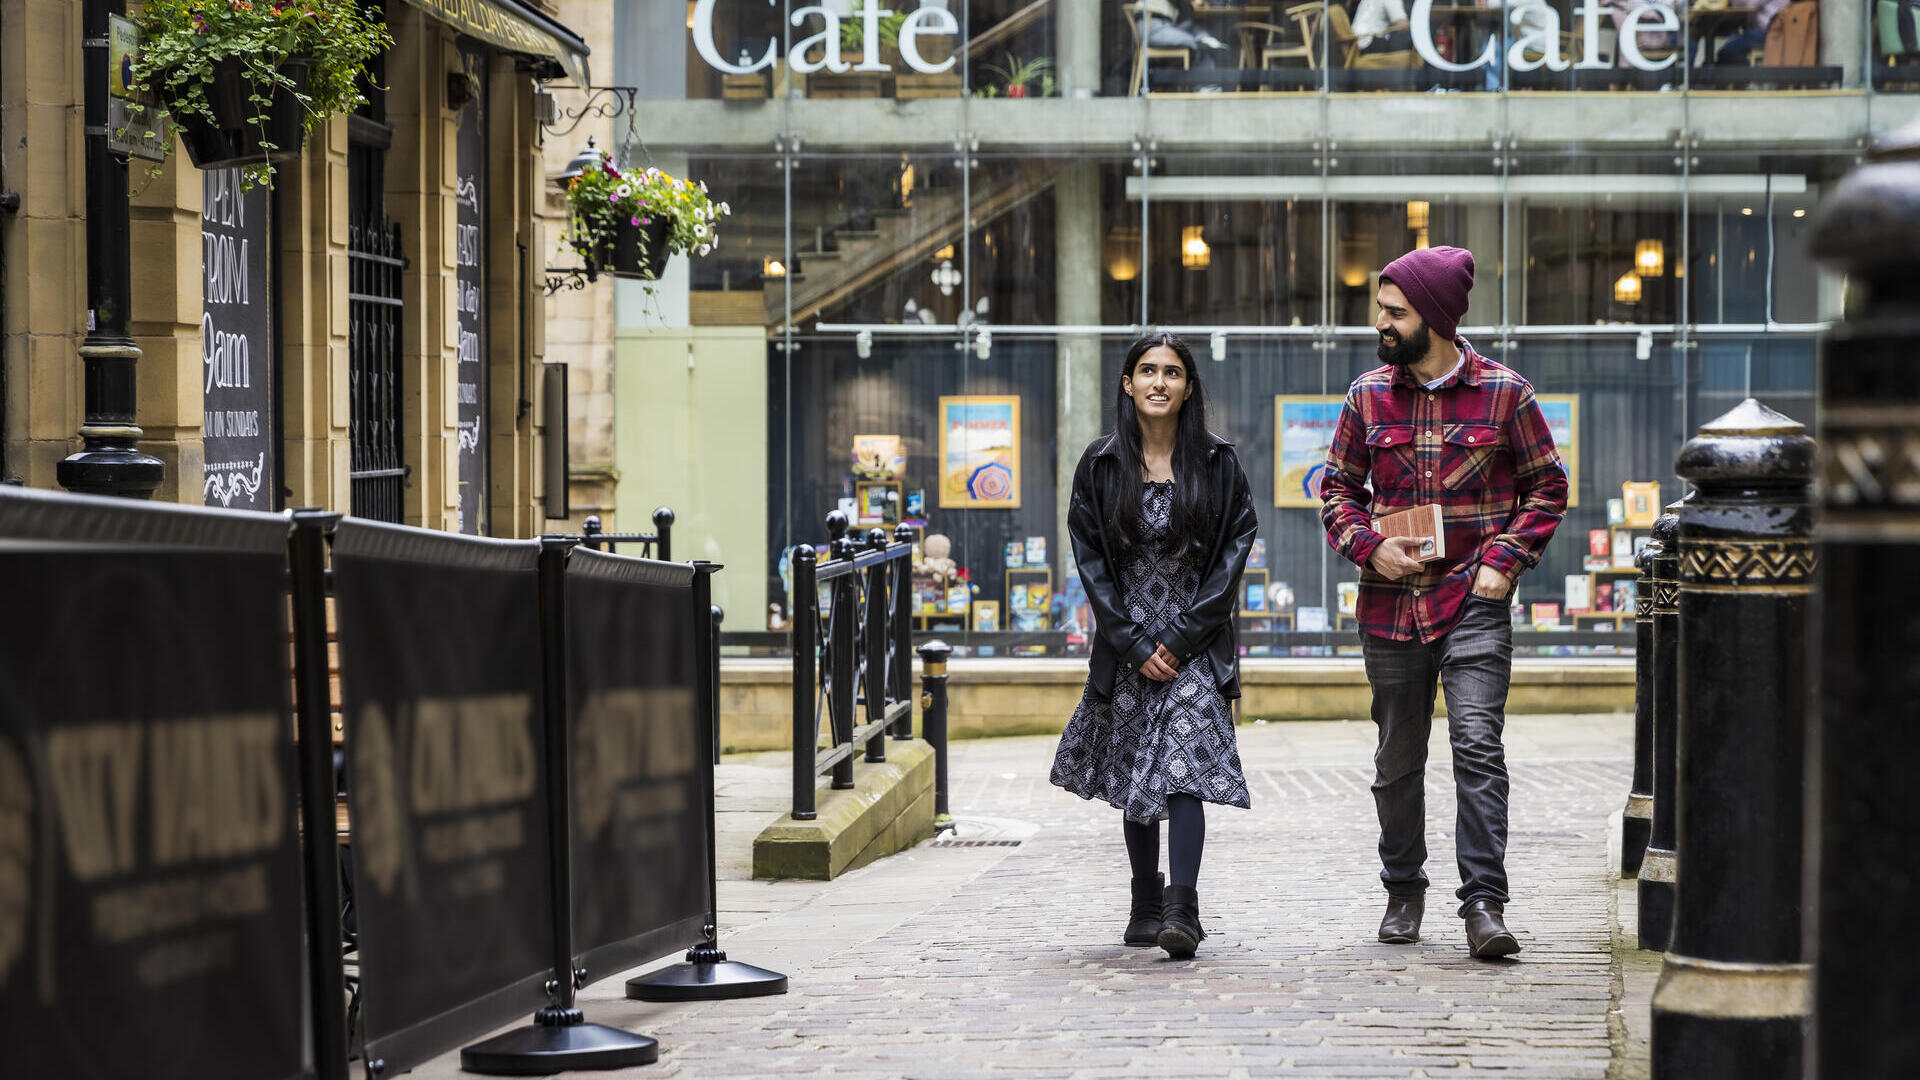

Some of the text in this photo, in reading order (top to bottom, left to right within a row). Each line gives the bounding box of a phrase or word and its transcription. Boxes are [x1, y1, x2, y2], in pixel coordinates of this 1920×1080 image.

[203, 311, 249, 394] 9am
[214, 411, 225, 438] ON
[226, 410, 258, 438] SUNDAYS
